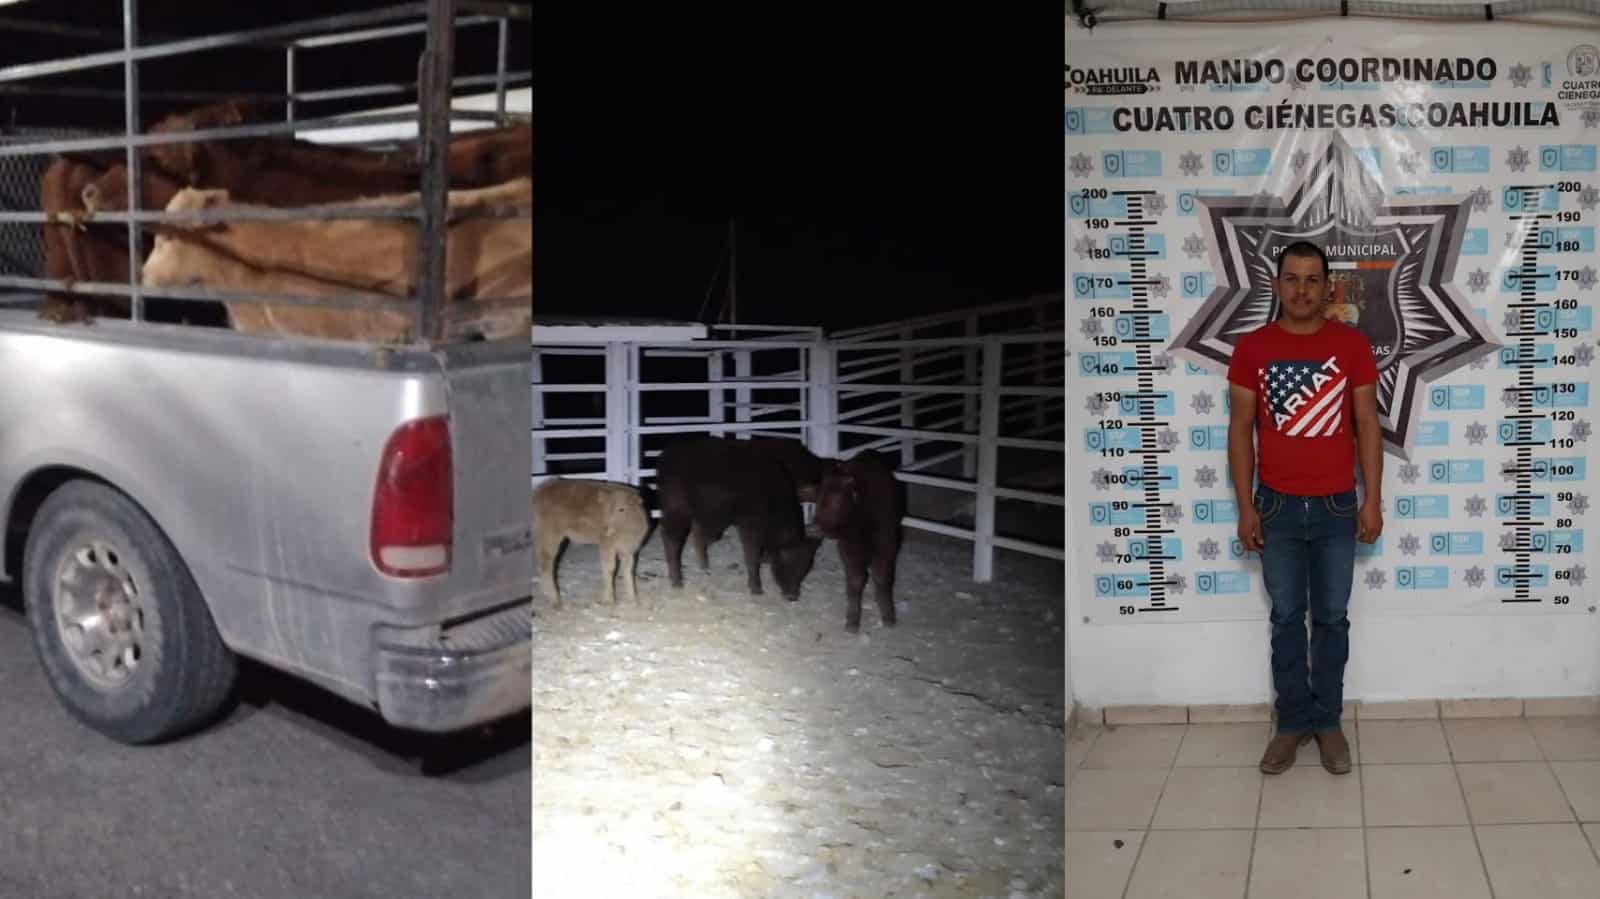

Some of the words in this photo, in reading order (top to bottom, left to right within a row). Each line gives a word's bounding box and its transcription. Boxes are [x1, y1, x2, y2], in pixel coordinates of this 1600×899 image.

[1174, 58, 1285, 84] MANDO
[1295, 57, 1497, 83] COORDINADO
[1563, 80, 1600, 90] CUATR
[1112, 105, 1234, 131] CUATRO
[1244, 99, 1396, 129] CIÉNEGAS
[1406, 101, 1560, 128] COAHUILA
[1557, 182, 1582, 193] 200
[1081, 188, 1107, 199] 200
[1556, 212, 1581, 222] 190
[1085, 218, 1109, 229] 190
[1325, 244, 1397, 257] MUNICIPAL
[1555, 241, 1580, 252] 180
[1087, 248, 1110, 259] 180
[1554, 271, 1579, 281] 170
[1088, 278, 1113, 288] 170
[1553, 299, 1578, 310] 160
[1090, 307, 1115, 318] 160
[1553, 328, 1578, 338] 150
[1092, 336, 1117, 346] 150
[1552, 355, 1576, 365] 140
[1095, 364, 1119, 374] 140
[1552, 383, 1576, 393] 130
[1096, 392, 1120, 402] 130
[1274, 356, 1341, 431] ARIAT
[1550, 411, 1575, 421] 120
[1098, 420, 1123, 430] 120
[1550, 438, 1574, 448] 110
[1100, 447, 1124, 457] 110
[1550, 465, 1574, 475] 100
[1103, 474, 1127, 484] 100
[1557, 492, 1573, 502] 90
[1112, 501, 1129, 511] 90
[1556, 518, 1572, 528] 80
[1114, 528, 1130, 537] 80
[1555, 544, 1572, 554] 70
[1115, 554, 1132, 564] 70
[1554, 570, 1570, 580] 60
[1117, 580, 1133, 590] 60
[1553, 596, 1570, 605] 50
[1119, 606, 1135, 615] 50
